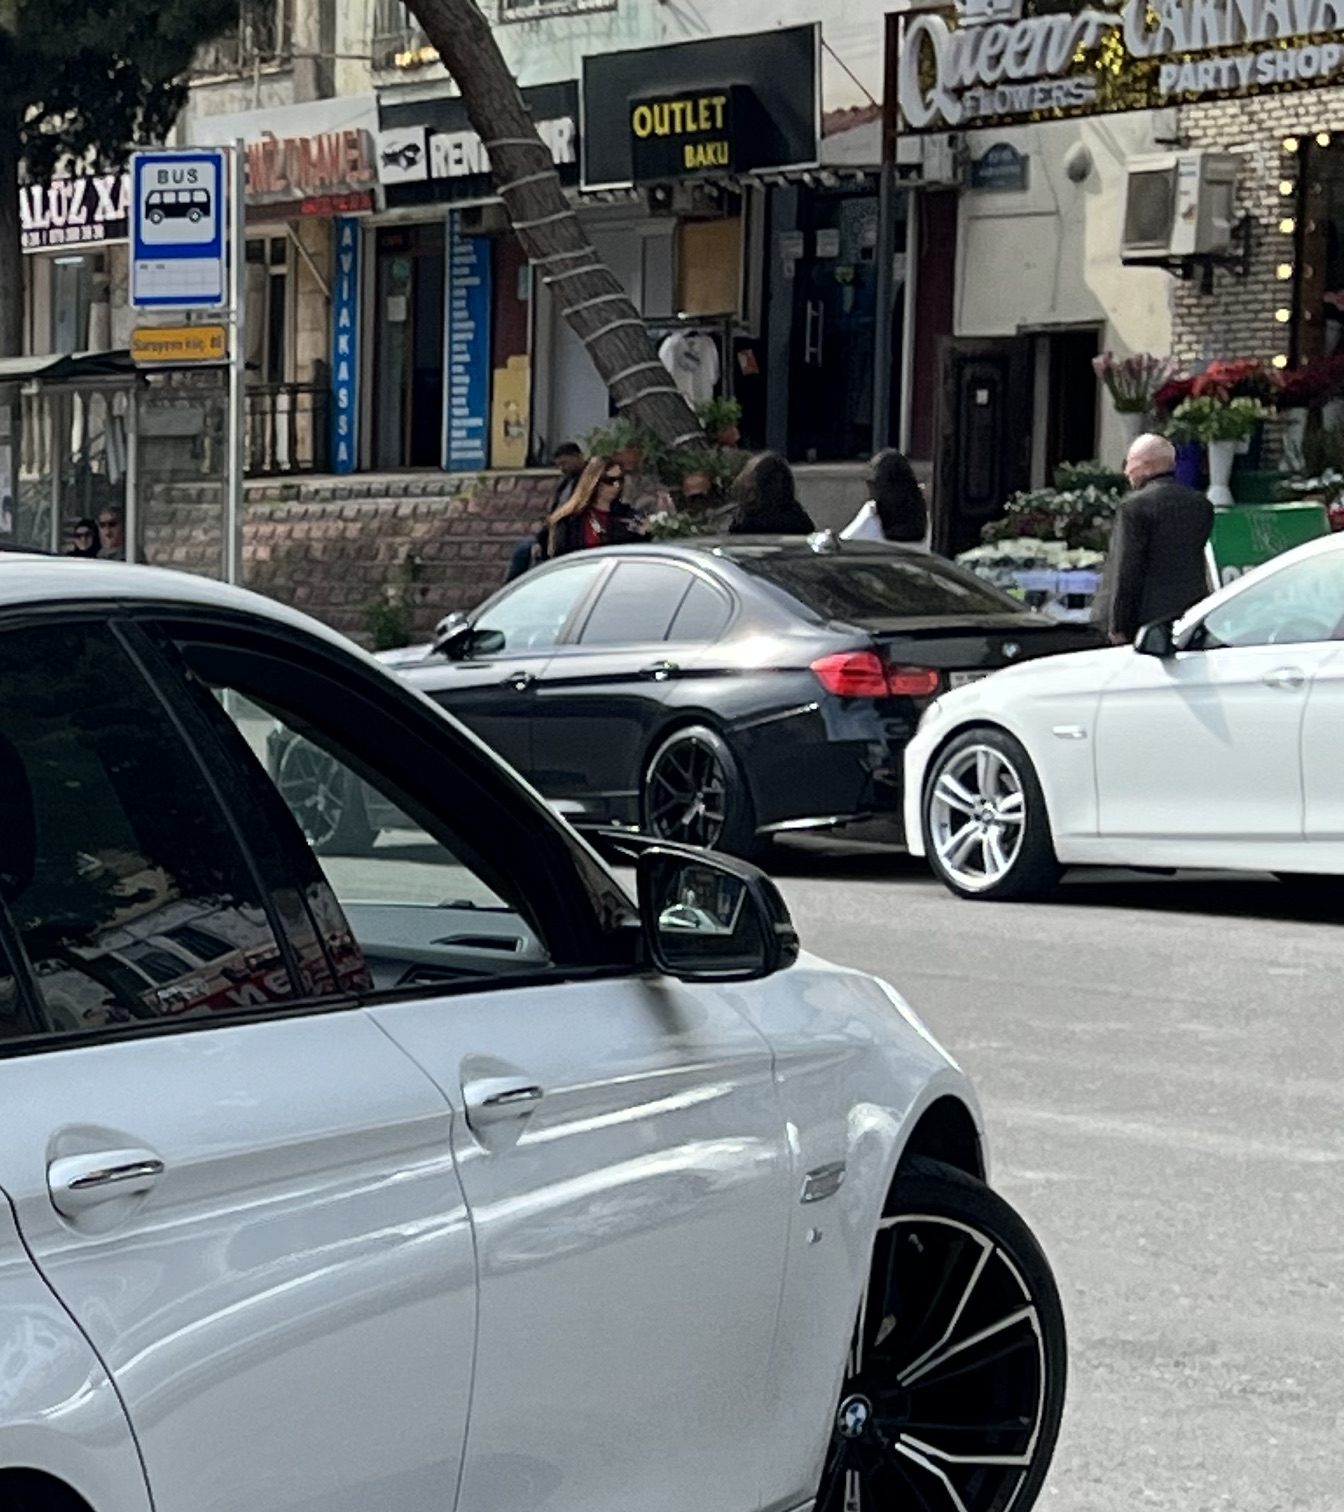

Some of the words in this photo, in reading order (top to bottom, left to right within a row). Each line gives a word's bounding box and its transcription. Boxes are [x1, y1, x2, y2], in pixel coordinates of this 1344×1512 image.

[1159, 53, 1255, 96] PARTY
[1256, 43, 1343, 85] SHOP
[963, 77, 1096, 113] FLOWERS
[632, 96, 727, 138] OUTLET
[429, 130, 492, 178] REN
[684, 141, 729, 168] BAKU
[157, 168, 199, 185] BUS
